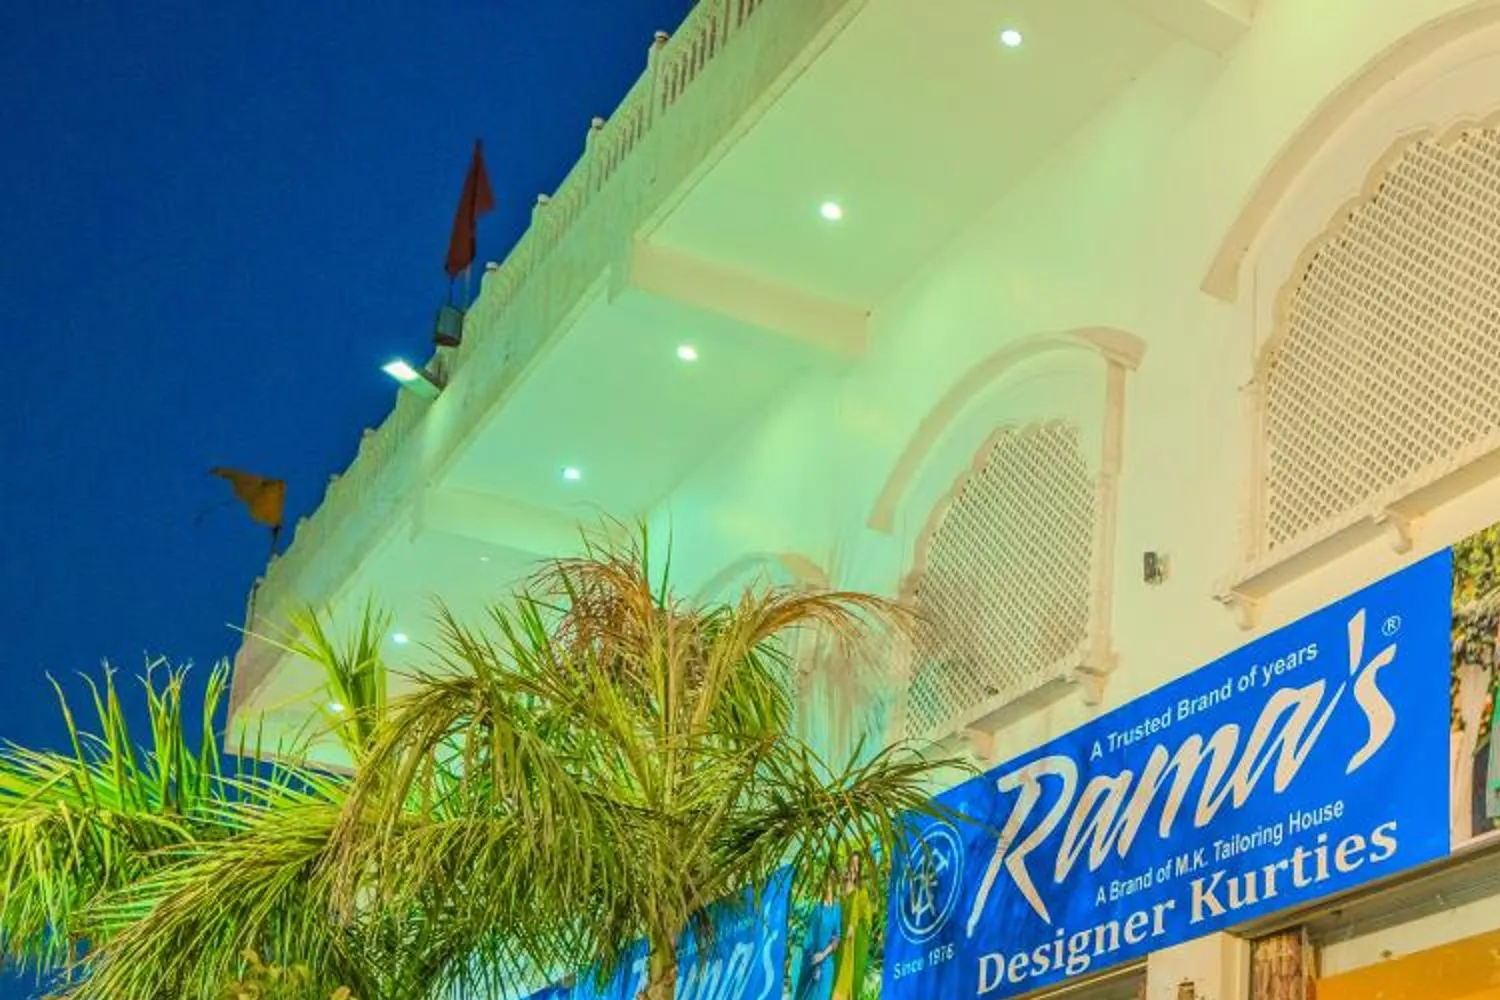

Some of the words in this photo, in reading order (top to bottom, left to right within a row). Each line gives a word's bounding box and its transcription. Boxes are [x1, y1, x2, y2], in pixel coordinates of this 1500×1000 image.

[1089, 740, 1103, 762] A
[1107, 706, 1172, 753] Trusted
[1176, 677, 1232, 722] Brand
[1237, 664, 1258, 692] of
[1262, 642, 1318, 687] years
[966, 607, 1398, 939] Rama's
[976, 898, 1176, 996] Designer
[1189, 818, 1398, 926] Kurties
[1095, 885, 1106, 907] A
[1109, 867, 1153, 902] Brand
[1156, 861, 1173, 885] of
[1174, 847, 1206, 877] M.K.
[1213, 822, 1284, 864] Tailoring
[1288, 799, 1345, 835] House
[893, 957, 925, 980] Since
